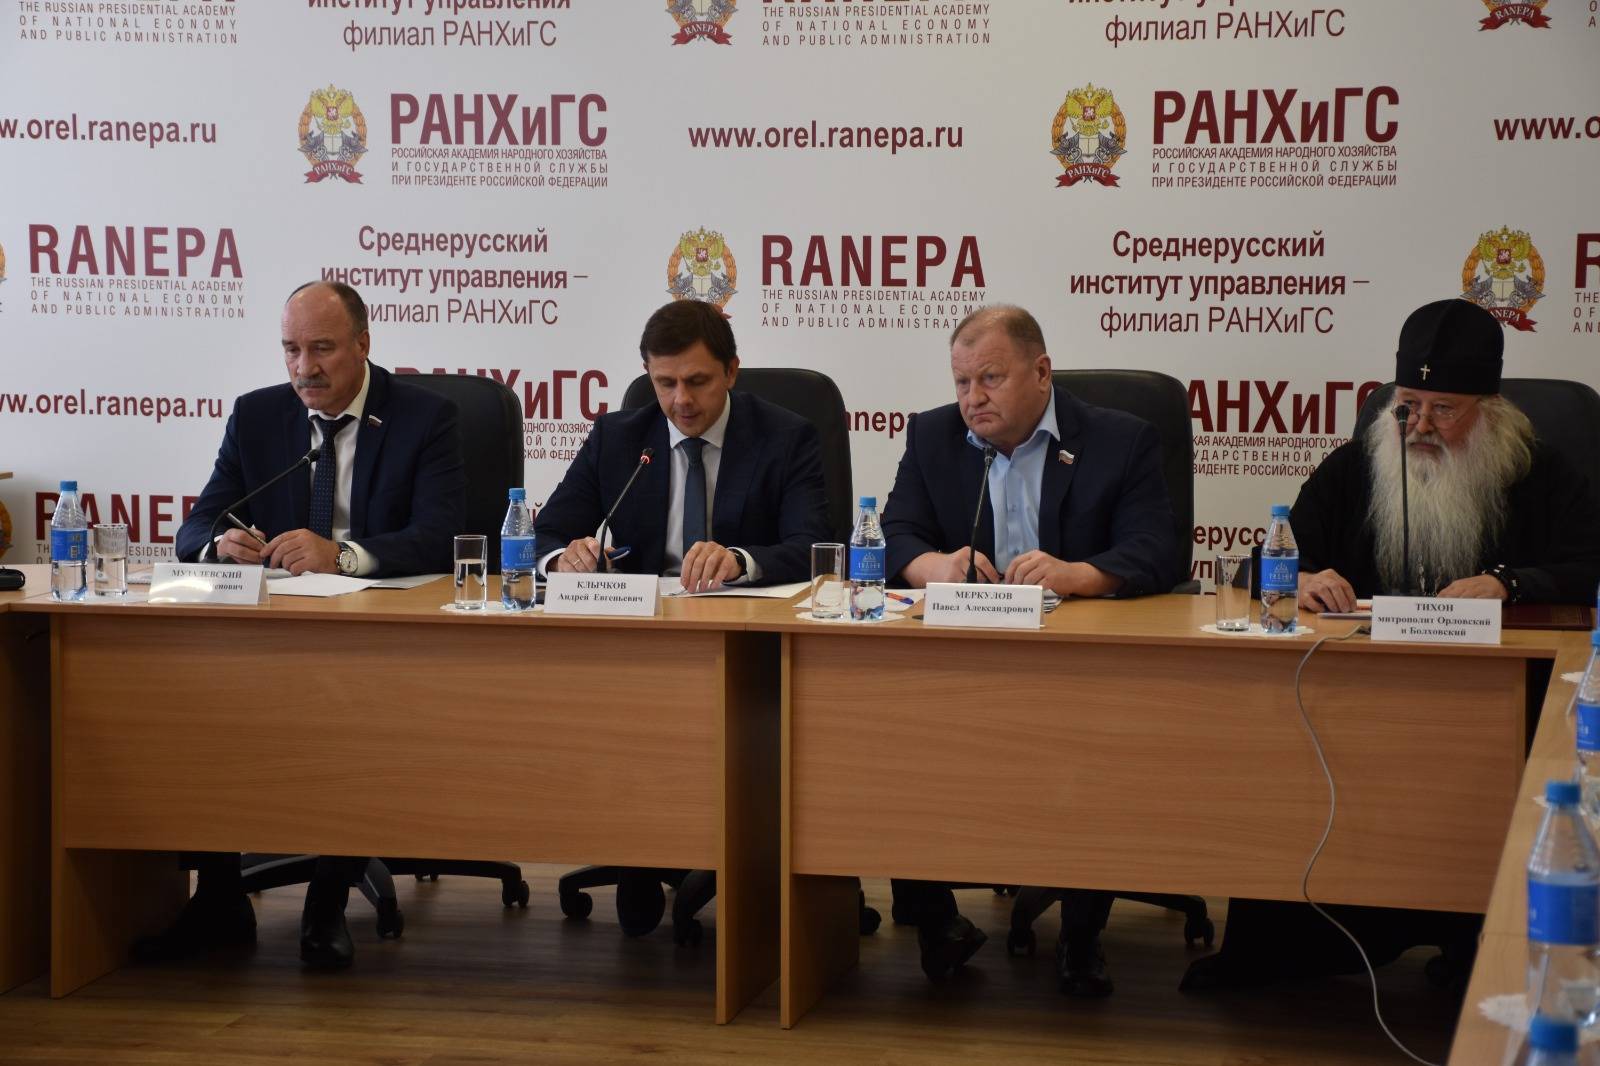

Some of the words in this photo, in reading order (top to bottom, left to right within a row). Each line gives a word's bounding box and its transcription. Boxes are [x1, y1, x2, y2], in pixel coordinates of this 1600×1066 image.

[19, 1, 40, 12] THE
[45, 2, 93, 14] RUSSIAN
[99, 3, 178, 15] PRESIDENTIAL
[183, 5, 236, 16] ACADEMY
[763, 6, 784, 17] THE
[789, 5, 840, 17] RUSSIAN
[845, 5, 929, 16] PRESIDENTIAL
[933, 4, 990, 15] ACADEMY
[1495, 6, 1535, 19] RANEPA
[19, 15, 38, 26] OF
[52, 16, 141, 28] NATIONAL
[154, 17, 236, 29] ECONOMY
[684, 23, 718, 35] RANEPA
[762, 21, 782, 32] OF
[796, 20, 888, 31] NATIONAL
[902, 18, 990, 31] ECONOMY
[1105, 14, 1206, 48] филиал
[1216, 9, 1346, 39] РАНХиГС
[20, 29, 48, 40] AND
[56, 30, 107, 42] PUBLIC
[115, 31, 238, 44] ADMINISTRATION
[343, 20, 435, 52] филиал
[443, 20, 557, 47] РАНХиГС
[762, 34, 791, 46] AND
[799, 34, 852, 46] PUBLIC
[860, 33, 991, 45] ADMINISTRATION
[390, 93, 608, 147] РАНХиГС
[1153, 86, 1399, 145] РАНХиГС
[688, 120, 963, 155] www.orel.ranepa.ru
[392, 148, 449, 159] РОССИЙСКАЯ
[451, 149, 499, 160] АКАДЕМИЯ
[501, 149, 554, 161] НАРОДНОГО
[556, 149, 607, 160] ХОЗЯЙСТВА
[1153, 147, 1217, 158] РОССИЙСКАЯ
[1219, 147, 1273, 160] АКАДЕМИЯ
[1275, 146, 1335, 159] НАРОДНОГО
[1338, 145, 1397, 157] ХОЗЯЙСТВА
[391, 162, 399, 172] И
[407, 161, 541, 174] ГОСУДАРСТВЕННОЙ
[550, 163, 608, 174] СЛУЖБЫ
[1153, 162, 1160, 173] И
[1169, 160, 1320, 175] ГОСУДАРСТВЕННОЙ
[1330, 160, 1397, 172] СЛУЖБЫ
[392, 175, 411, 186] ПРИ
[414, 175, 477, 188] ПРЕЗИДЕНТЕ
[480, 174, 545, 187] РОССИЙСКОЙ
[548, 177, 608, 188] ФЕДЕРАЦИИ
[1152, 177, 1174, 188] ПРИ
[1177, 176, 1247, 188] ПРЕЗИДЕНТЕ
[1250, 174, 1324, 187] РОССИЙСКОЙ
[1328, 175, 1397, 187] ФЕДЕРАЦИИ
[358, 225, 548, 258] Среднерусский
[1112, 230, 1325, 264] Среднерусский
[29, 224, 243, 278] RANEPA
[761, 235, 986, 287] RANEPA
[31, 277, 50, 287] THE
[56, 278, 104, 289] RUSSIAN
[109, 279, 187, 290] PRESIDENTIAL
[191, 280, 243, 291] ACADEMY
[321, 266, 423, 294] институт
[429, 268, 568, 294] управления
[1070, 275, 1183, 301] институт
[1190, 275, 1346, 301] управления
[31, 290, 49, 300] OF
[63, 291, 150, 303] NATIONAL
[163, 293, 243, 305] ECONOMY
[763, 289, 783, 300] THE
[788, 289, 838, 301] RUSSIAN
[843, 290, 926, 301] PRESIDENTIAL
[930, 290, 986, 302] ACADEMY
[32, 304, 58, 314] AND
[66, 305, 116, 315] PUBLIC
[124, 306, 244, 318] ADMINISTRATION
[365, 302, 439, 323] илиал
[447, 298, 559, 325] РАНХиГС
[762, 303, 781, 314] OF
[795, 303, 885, 315] NATIONAL
[762, 316, 789, 327] AND
[798, 316, 850, 328] PUBLIC
[858, 317, 959, 329] ADMINISTRAT
[1100, 306, 1199, 338] филиал
[1208, 307, 1334, 333] РАНХиГС
[1573, 322, 1600, 333] AN
[0, 389, 223, 423] w.orel.ranepa.ru
[1187, 380, 1384, 435] АНХиГ
[1212, 436, 1266, 448] АКАДЕМИЯ
[1268, 437, 1327, 449] НАРОДНОГО
[1194, 450, 1311, 462] УДАРСТВЕННОЙ
[1194, 463, 1239, 476] ЗИДЕНТЕ
[577, 581, 627, 590] КЛЫЧКОВ
[559, 593, 589, 602] Андрей
[593, 594, 643, 602] Евгеньевич
[955, 590, 1013, 600] МЕРКУЛОВ
[932, 603, 960, 611] Павел
[964, 604, 1034, 614] Александрович
[1415, 603, 1454, 612] ТИХОН
[1378, 616, 1434, 625] митрополит
[1437, 616, 1491, 626] Орловский
[1410, 627, 1466, 636] Болховский
